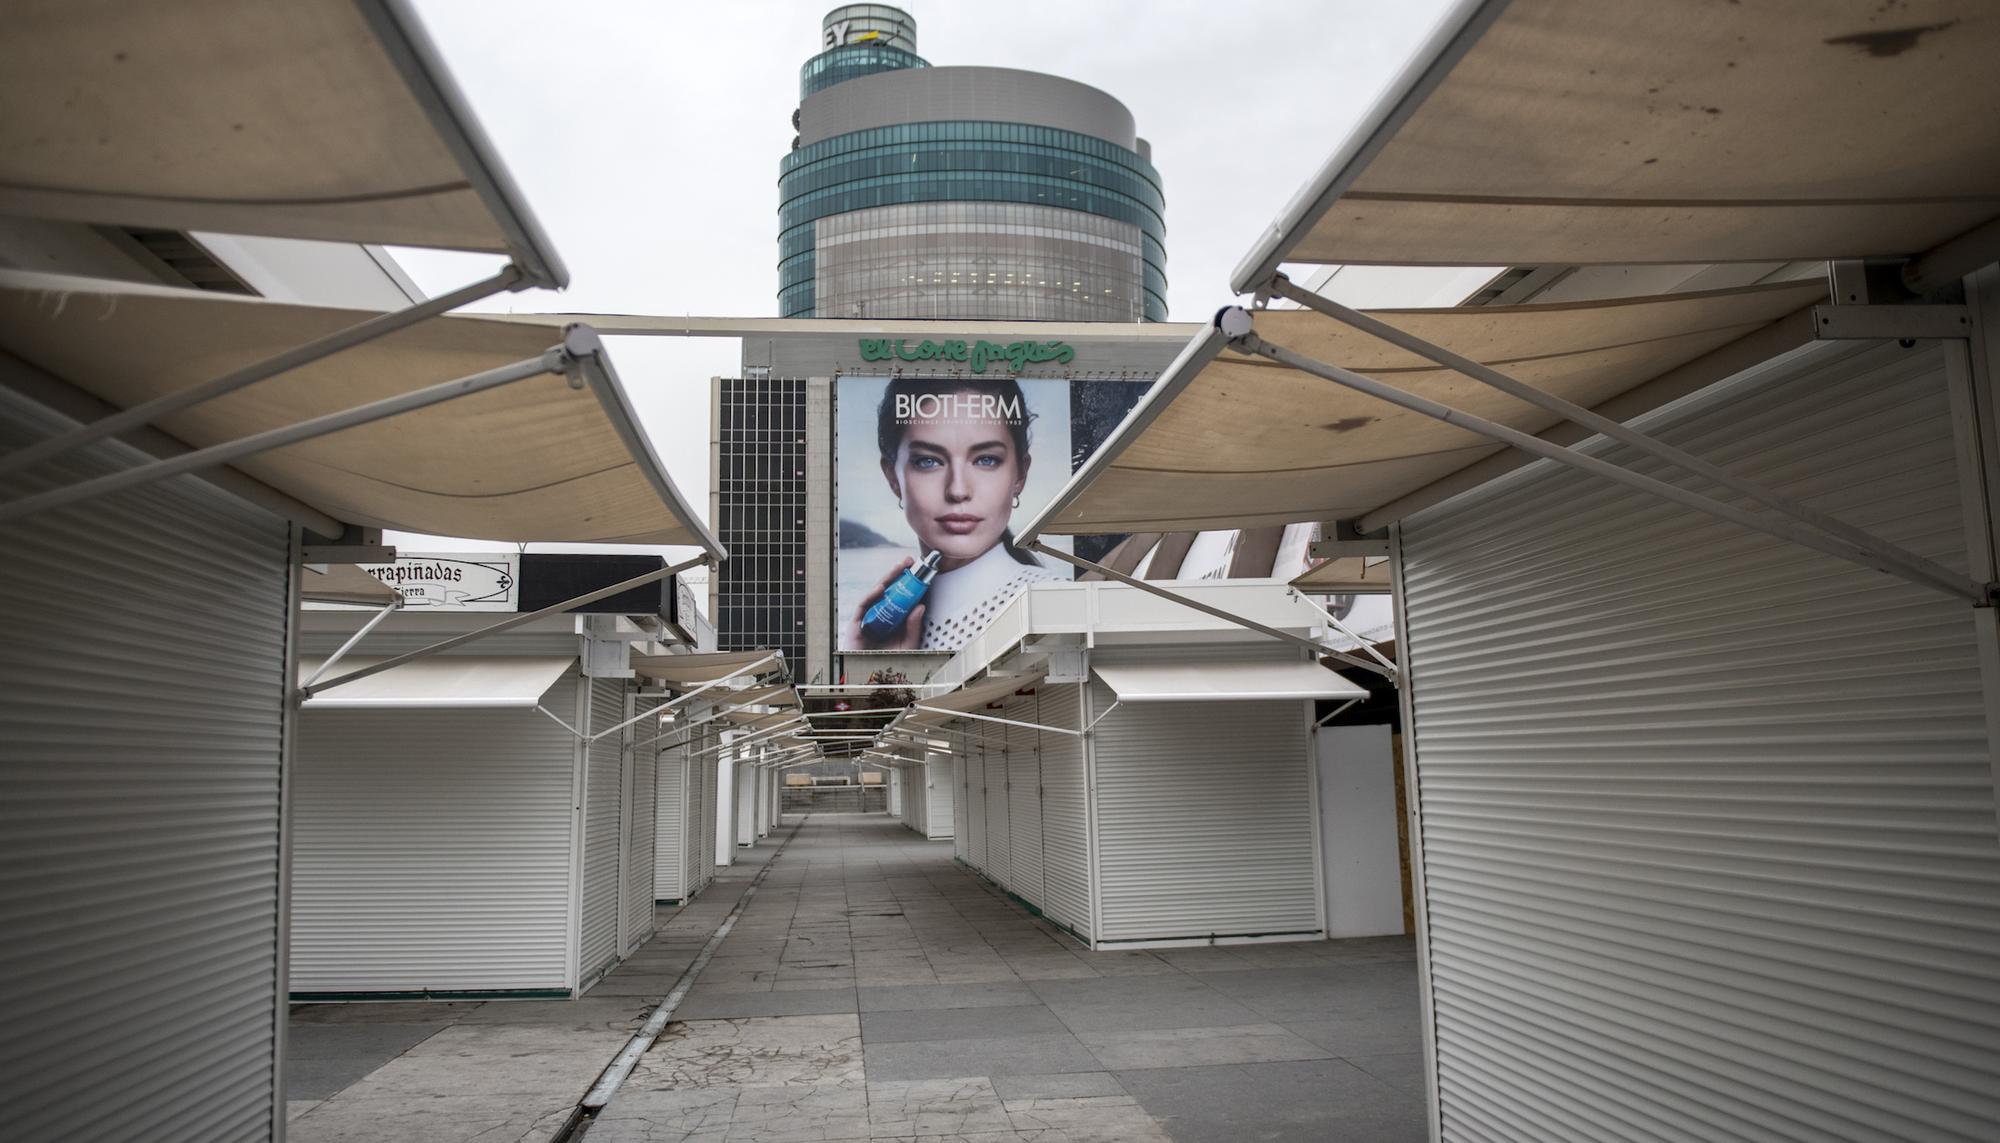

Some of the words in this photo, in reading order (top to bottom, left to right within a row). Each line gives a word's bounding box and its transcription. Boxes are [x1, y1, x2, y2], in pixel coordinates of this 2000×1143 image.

[823, 20, 850, 53] EY
[859, 339, 892, 362] El
[895, 339, 968, 362] Corte
[970, 339, 1075, 374] Inglés
[895, 393, 1022, 419] BIOTHERM
